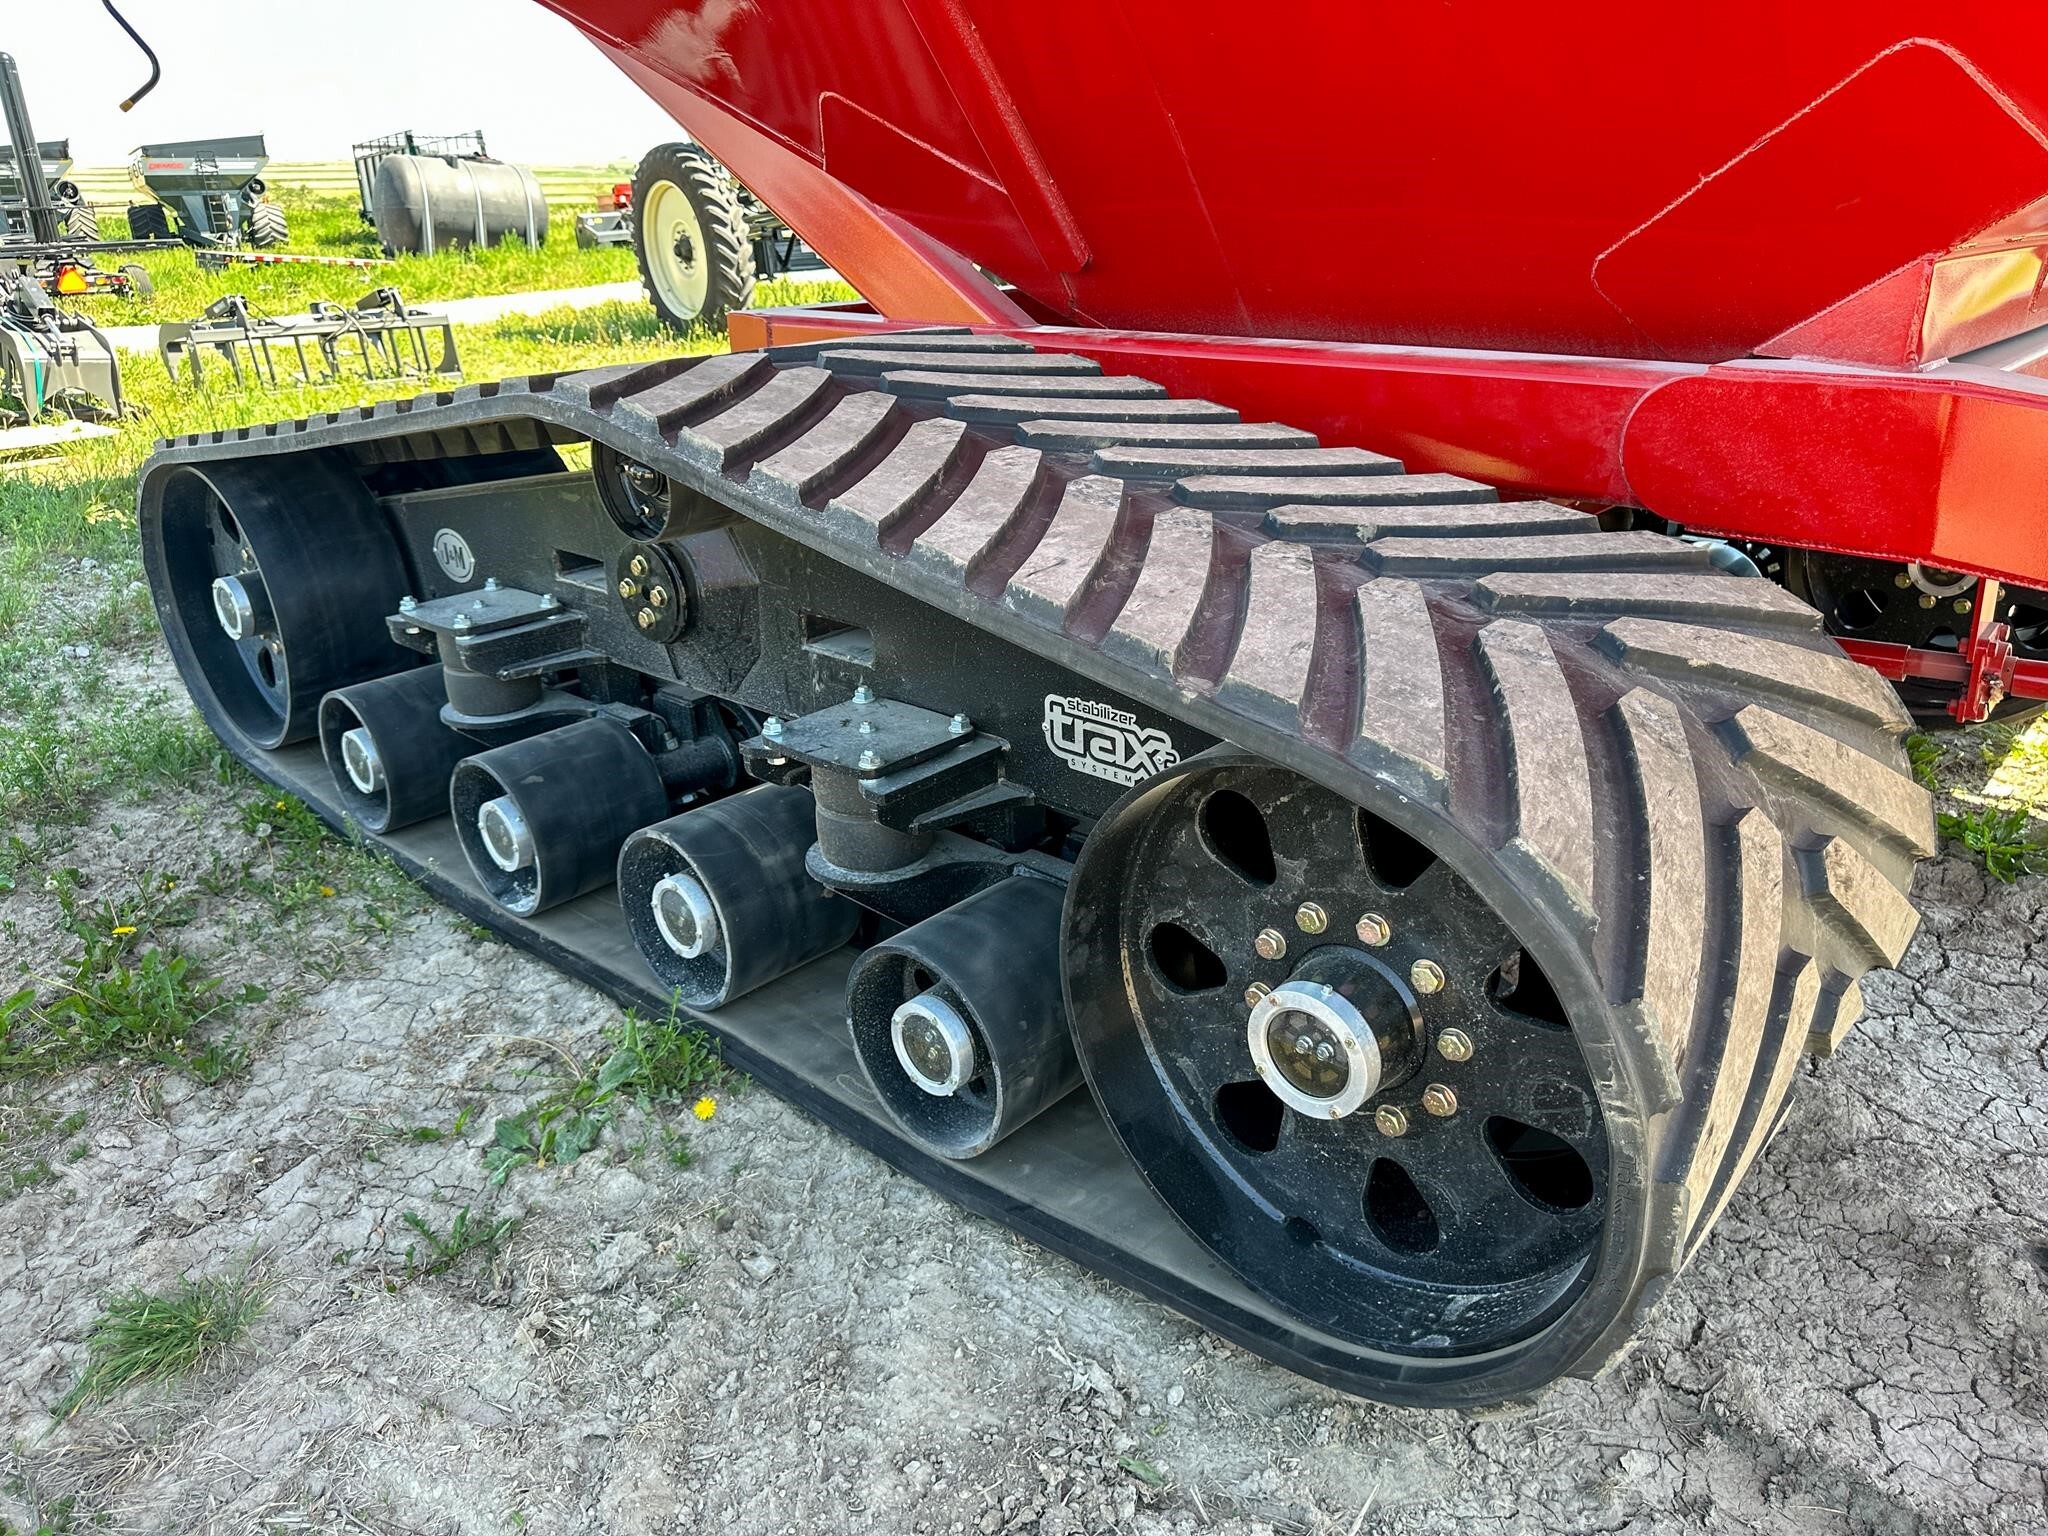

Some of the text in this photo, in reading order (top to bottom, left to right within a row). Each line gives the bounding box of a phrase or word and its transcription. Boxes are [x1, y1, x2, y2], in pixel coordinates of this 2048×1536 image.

[1067, 699, 1135, 725] stabilizer
[1049, 703, 1167, 777] trax
[1071, 758, 1133, 783] SYSTEM
